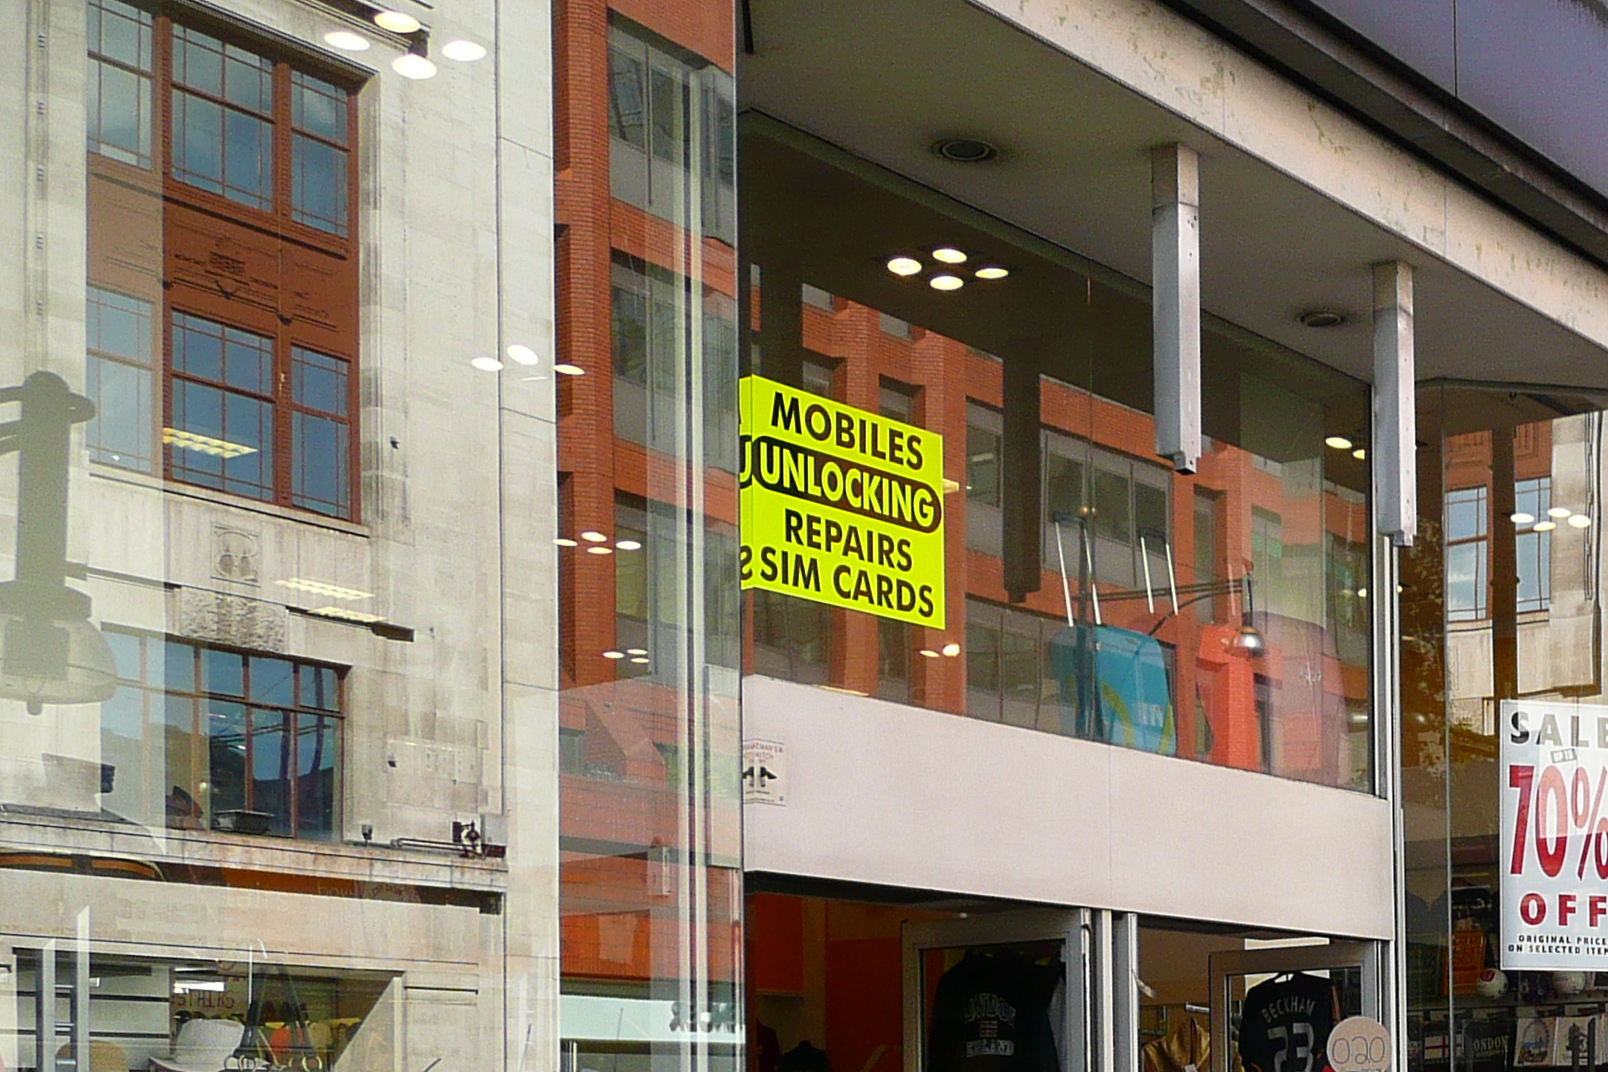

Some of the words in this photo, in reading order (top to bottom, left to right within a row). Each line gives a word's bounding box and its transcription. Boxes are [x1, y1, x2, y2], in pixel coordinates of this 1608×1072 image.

[771, 392, 923, 471] MOBILES
[760, 441, 934, 527] UNLOCKING
[785, 508, 913, 572] REPAIRS
[760, 546, 821, 592] SIM
[832, 565, 934, 618] CARDS
[1520, 892, 1608, 928] OFF
[1518, 935, 1571, 944] ORIGINAL
[1577, 937, 1607, 946] PRICE
[1529, 945, 1581, 954] SELECTED
[1261, 995, 1315, 1023] BECKHAM
